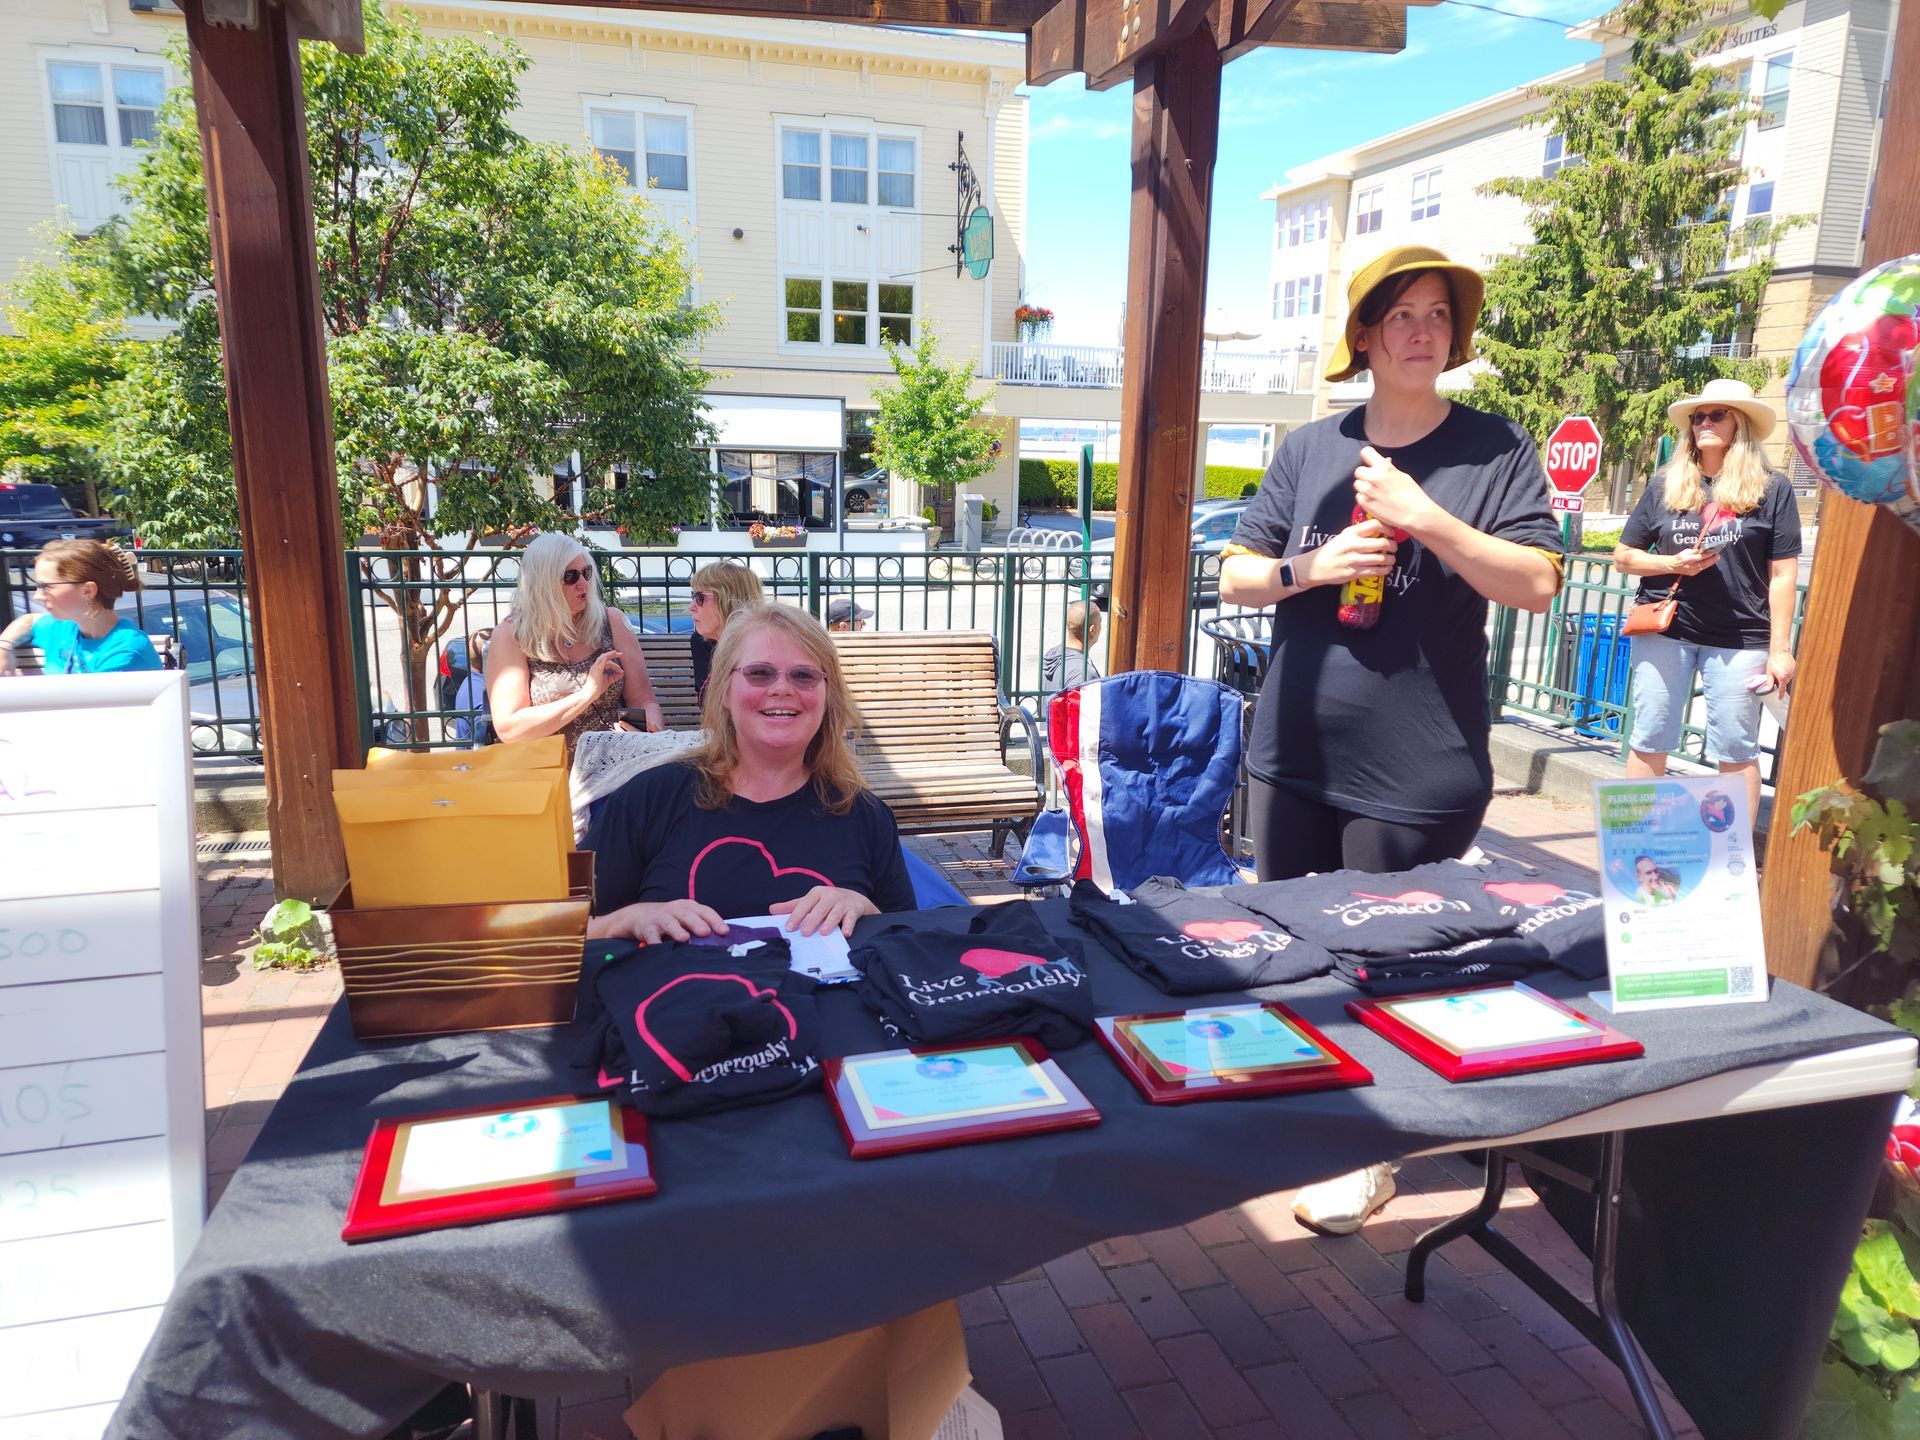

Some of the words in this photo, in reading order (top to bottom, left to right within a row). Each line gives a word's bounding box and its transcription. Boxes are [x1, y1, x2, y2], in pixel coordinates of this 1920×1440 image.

[1732, 23, 1778, 47] SUITES
[1549, 441, 1597, 471] STOP
[1553, 498, 1565, 508] ALL
[1567, 498, 1581, 510] WAY
[1671, 519, 1700, 531] Live
[899, 973, 967, 993] Live
[908, 969, 1082, 1007] Generously
[689, 1041, 790, 1083] enerously
